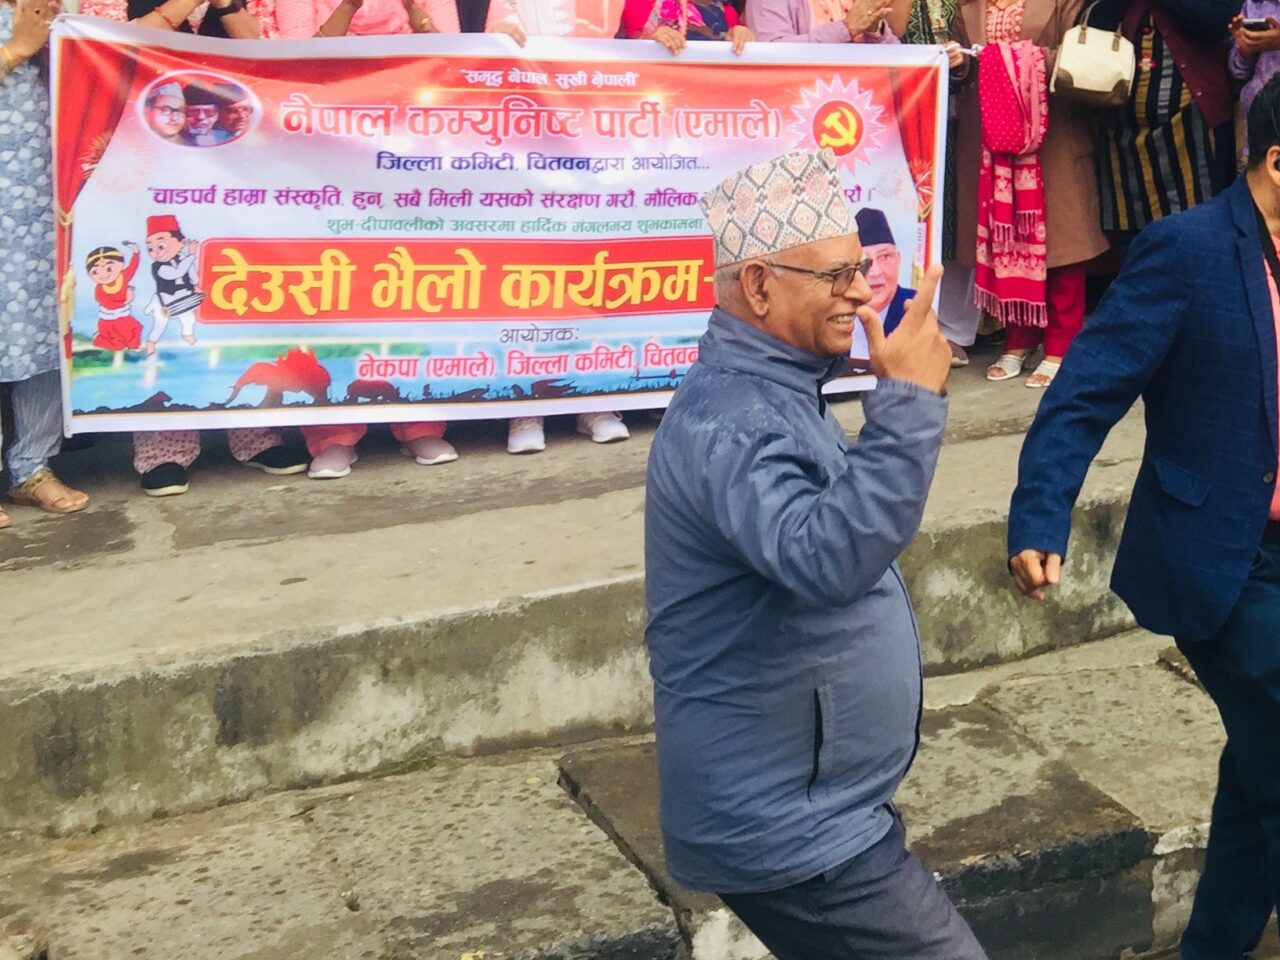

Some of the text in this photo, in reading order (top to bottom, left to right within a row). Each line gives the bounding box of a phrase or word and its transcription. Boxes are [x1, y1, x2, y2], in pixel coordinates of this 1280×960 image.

[281, 93, 783, 146] नेपाल कम्युनिष्ट पार्टी (एमाले)
[376, 150, 442, 171] जिल्ला
[392, 188, 422, 208] सबै
[428, 188, 474, 208] मिली
[479, 188, 533, 208] यसको
[540, 189, 600, 209] संरक्षण
[450, 219, 516, 233] अवसरमा
[520, 216, 567, 233] हार्दिक
[572, 218, 633, 233] मंगलमय
[211, 247, 357, 317] देउसी
[370, 246, 487, 313] भैलो
[358, 352, 418, 379] नेकपा
[506, 350, 569, 376] जिल्ला
